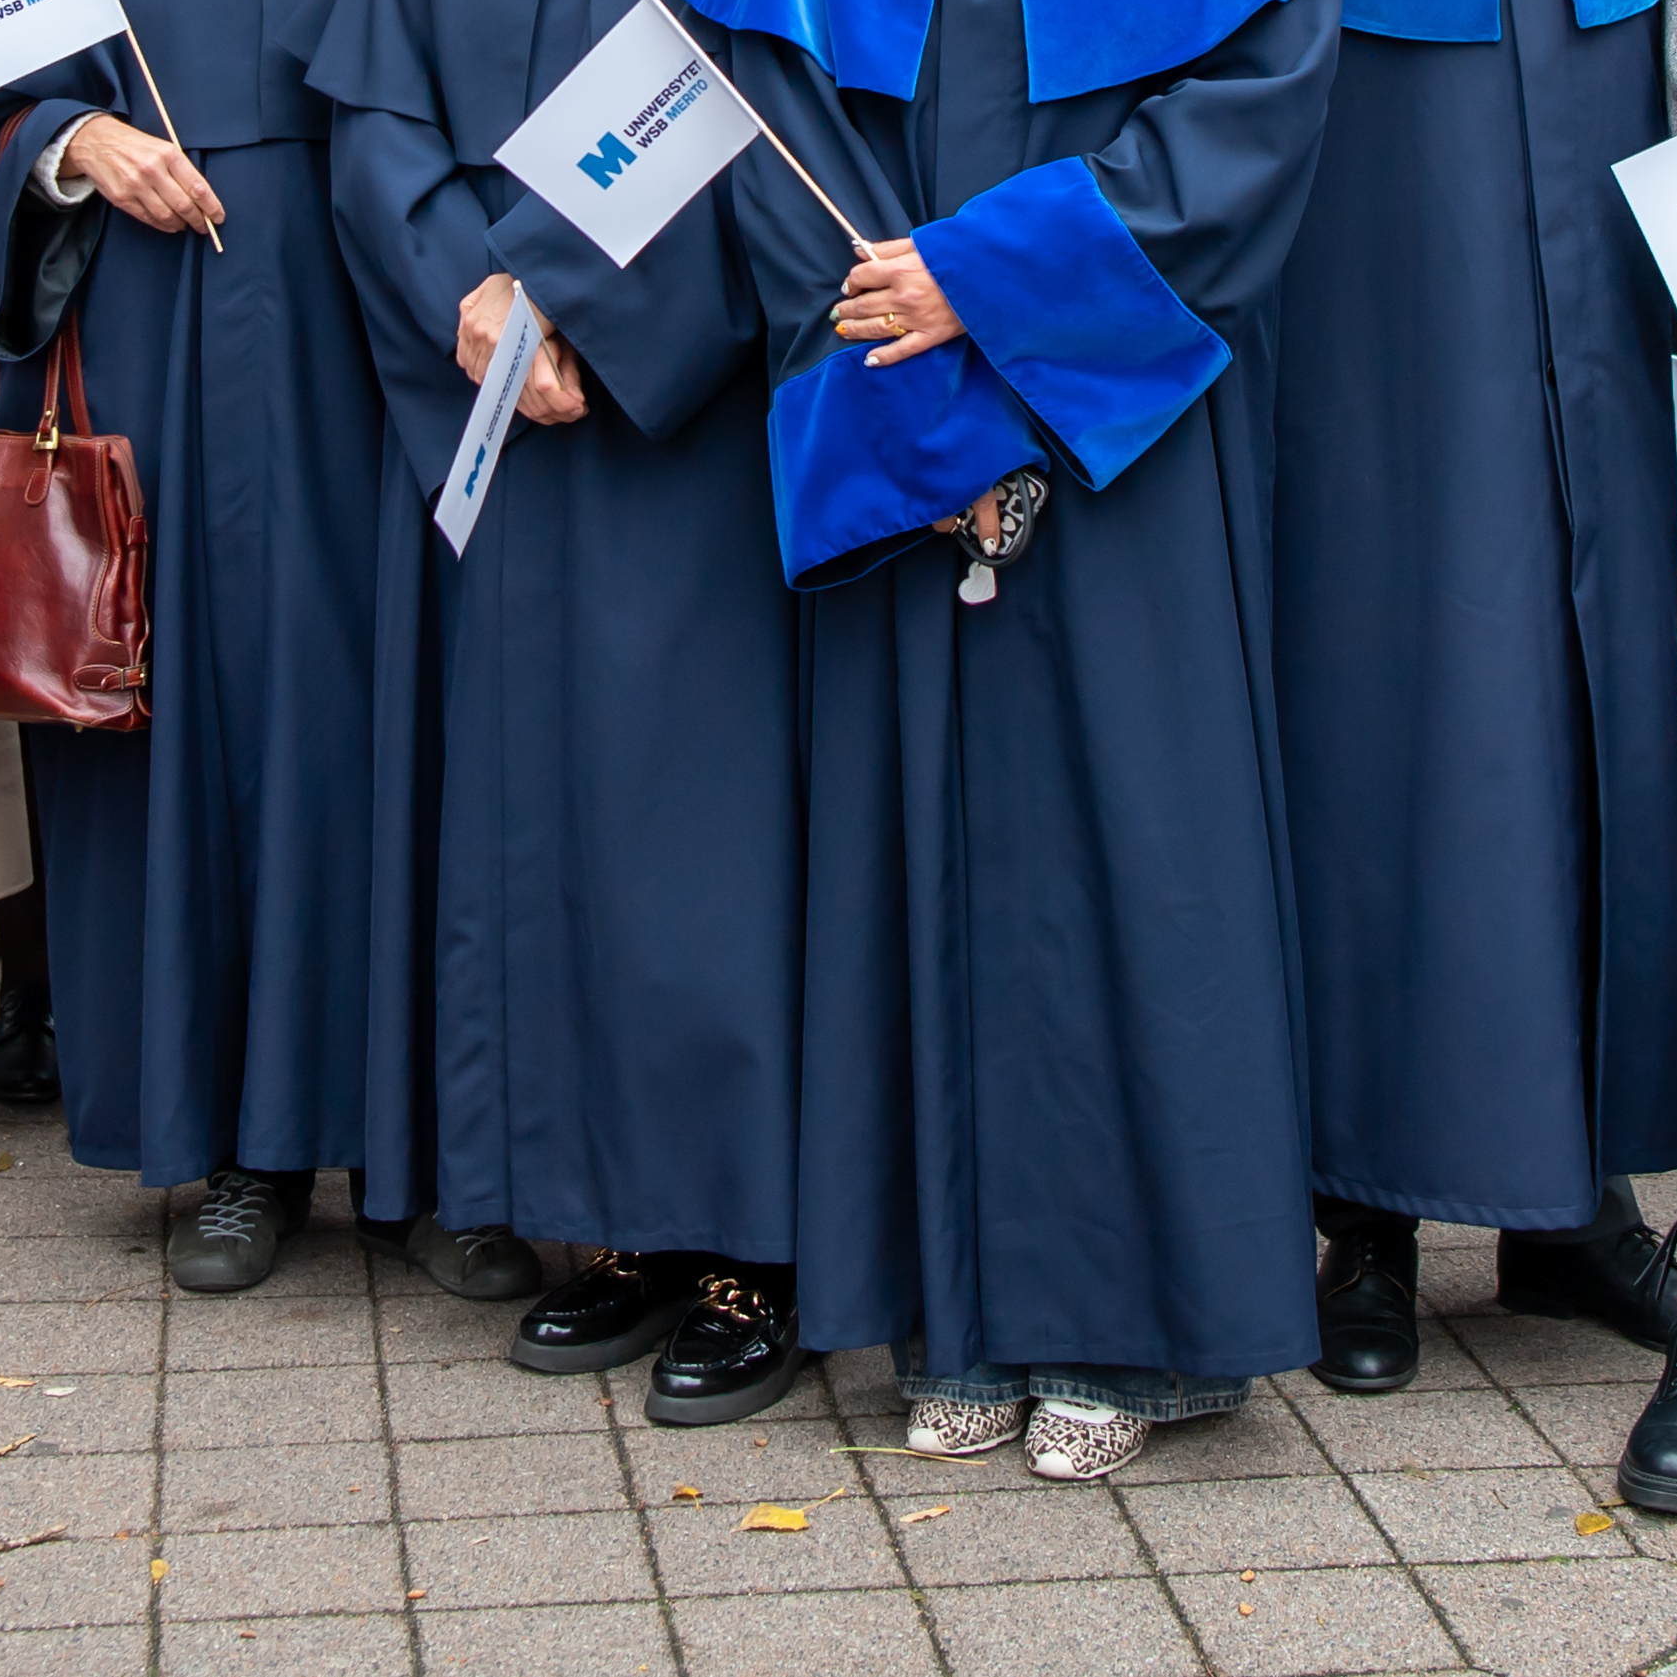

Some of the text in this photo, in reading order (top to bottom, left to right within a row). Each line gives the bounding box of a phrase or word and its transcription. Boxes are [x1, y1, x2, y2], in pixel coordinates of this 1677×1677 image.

[623, 59, 703, 138] UNIWERSYTET
[636, 78, 708, 149] WSB MERITO
[576, 131, 637, 190] M
